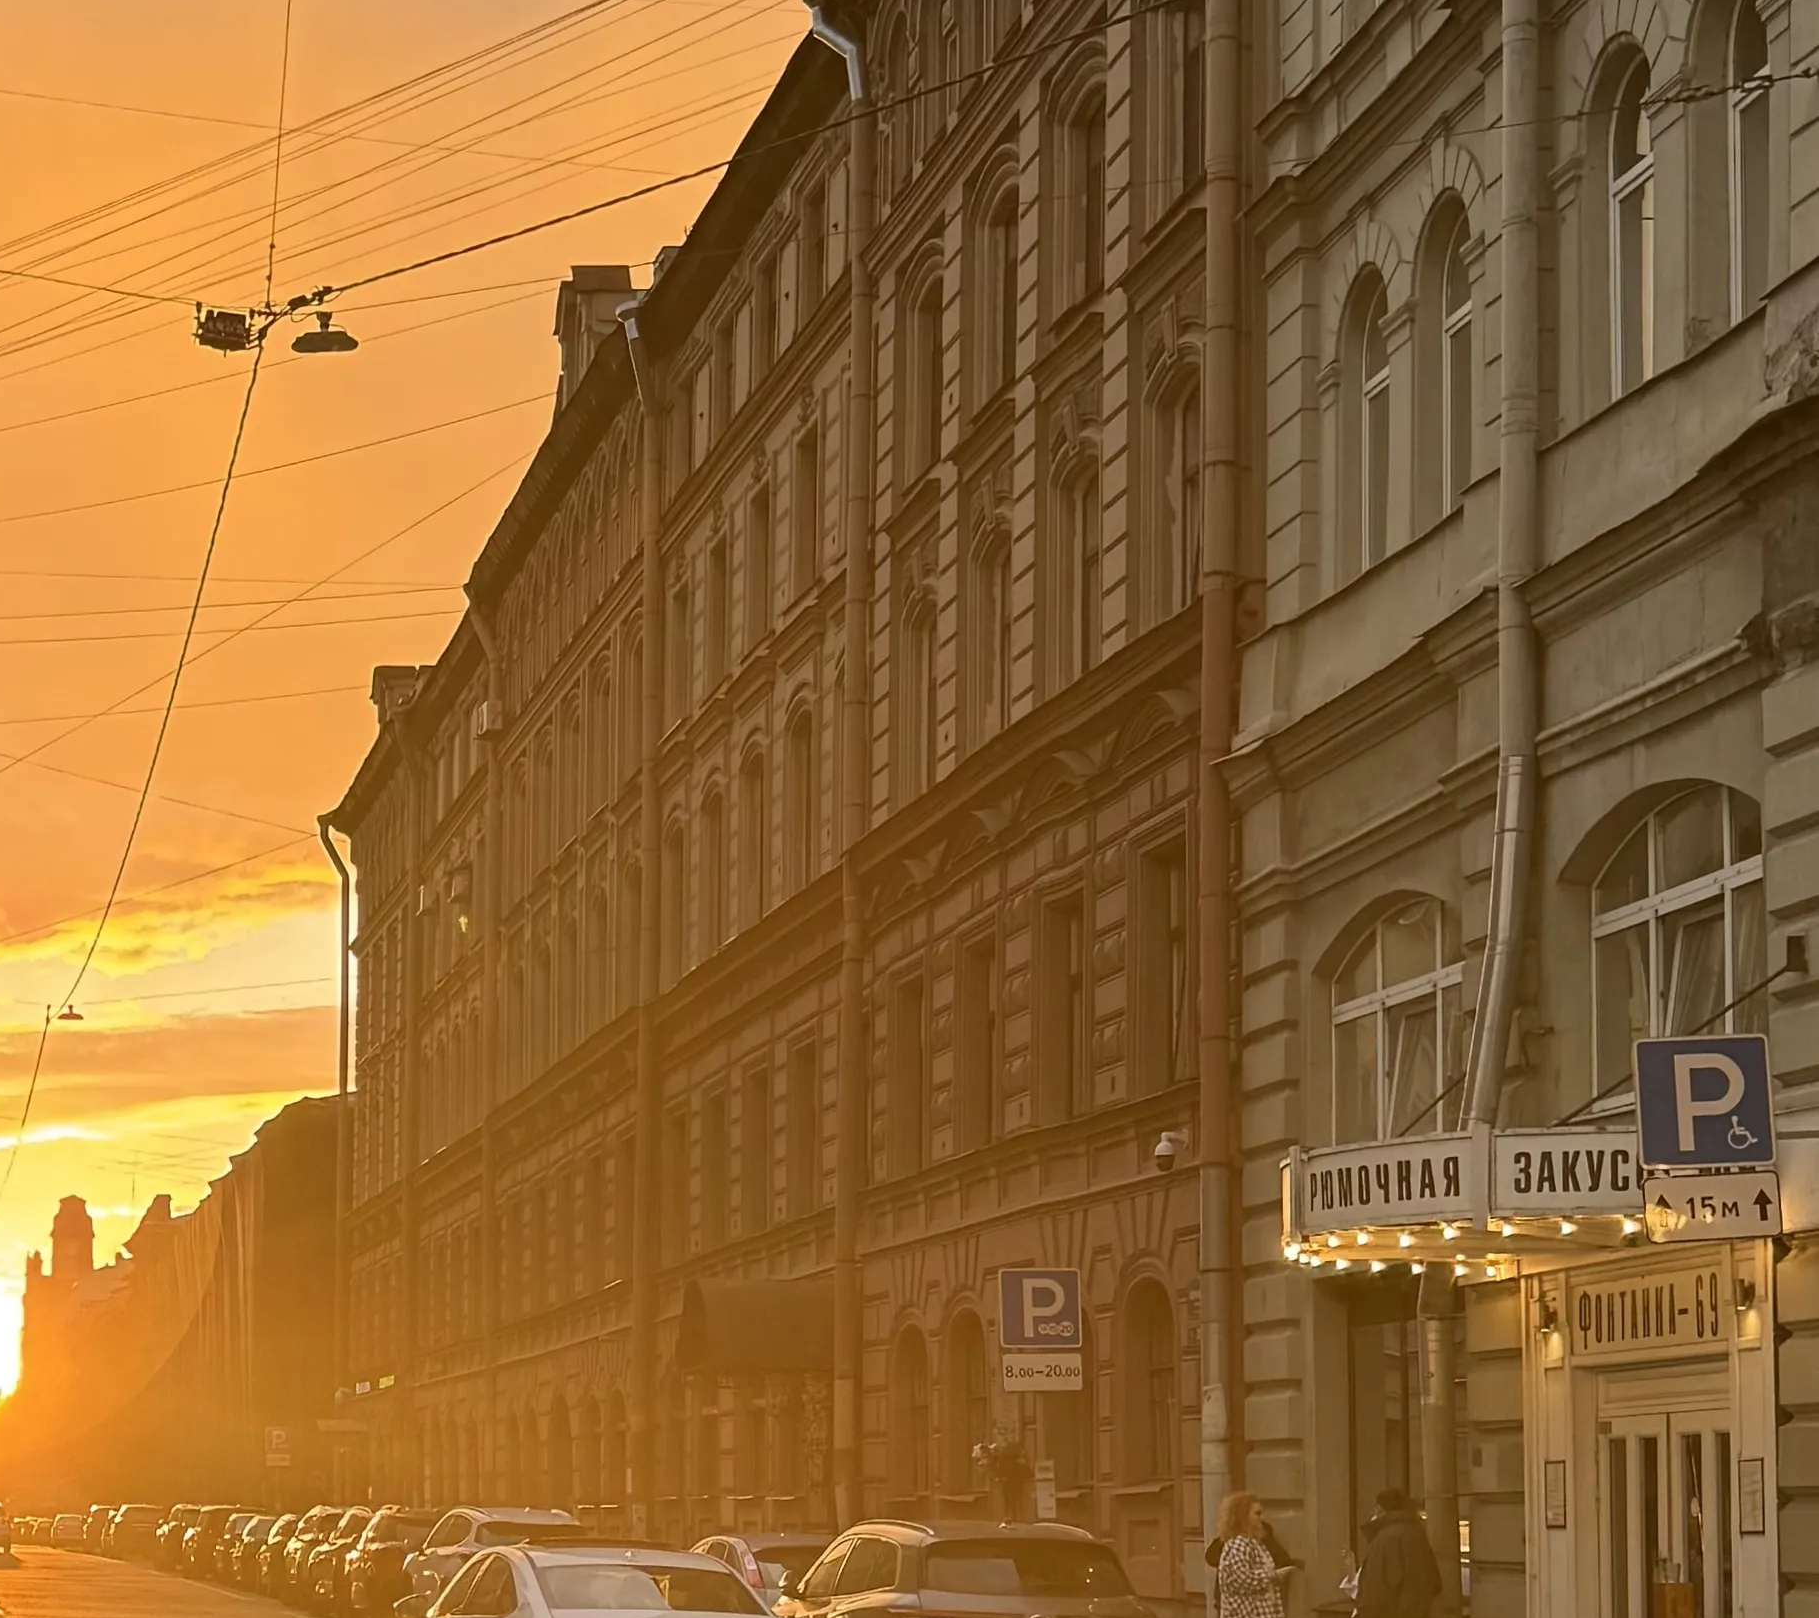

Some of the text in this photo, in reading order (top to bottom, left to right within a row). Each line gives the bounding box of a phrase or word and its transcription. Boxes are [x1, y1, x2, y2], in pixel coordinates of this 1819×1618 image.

[1674, 1052, 1745, 1152] P
[1310, 1149, 1644, 1212] РЮМОЧНАЯ ЗАКУС
[1022, 1278, 1065, 1338] P
